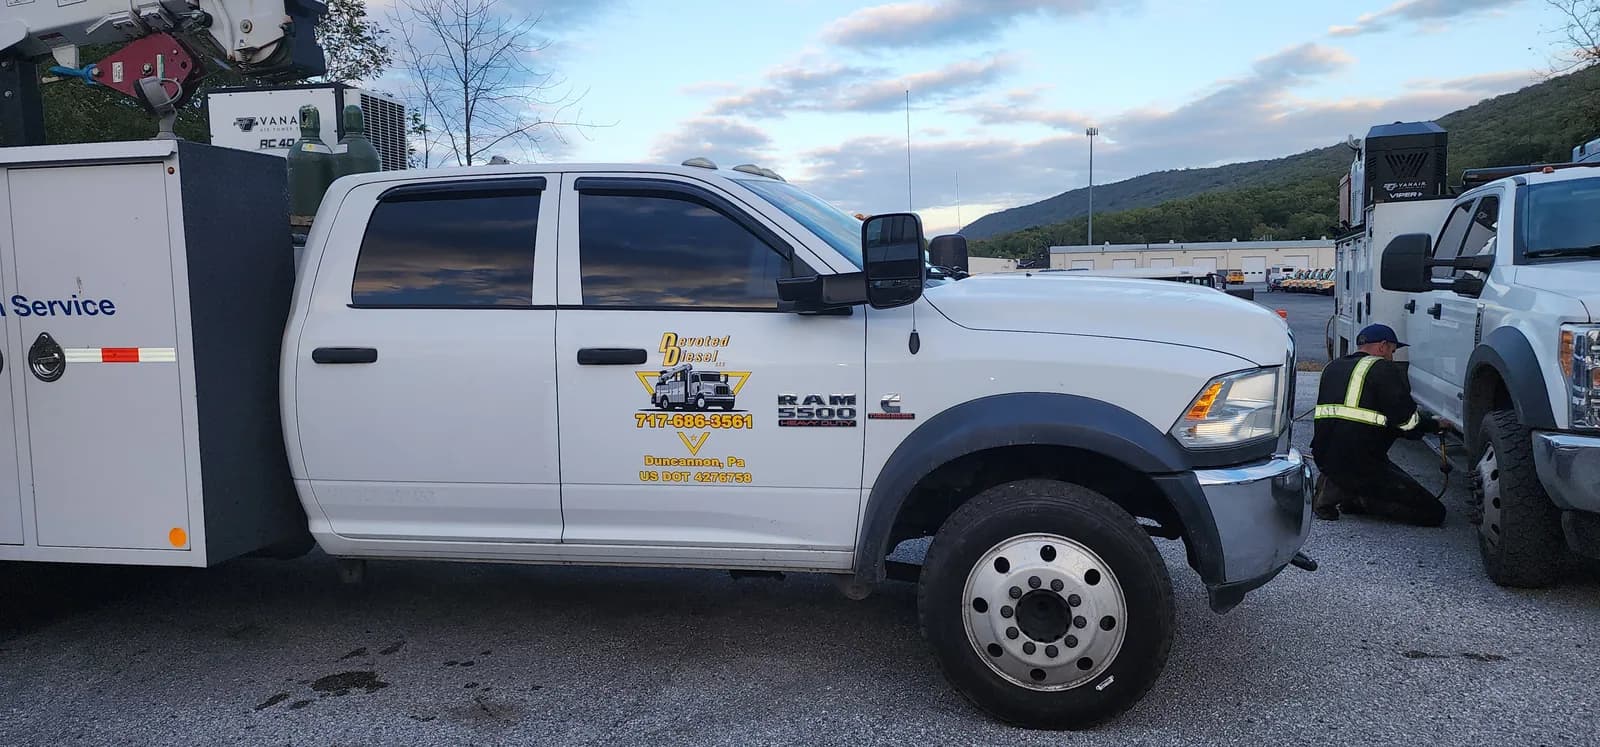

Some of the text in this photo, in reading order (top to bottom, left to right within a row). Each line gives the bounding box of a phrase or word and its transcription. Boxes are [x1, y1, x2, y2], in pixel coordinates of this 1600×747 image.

[260, 116, 299, 126] VANA
[1390, 191, 1418, 199] VIPER
[11, 294, 116, 317] Service
[659, 332, 731, 353] Devoted
[663, 346, 719, 366] Diesel
[778, 393, 857, 406] RAM
[778, 406, 857, 420] 5500
[635, 413, 753, 429] 717-686-3561
[644, 455, 745, 469] Duncannon, Pa
[639, 471, 752, 484] US DOT 4276758
